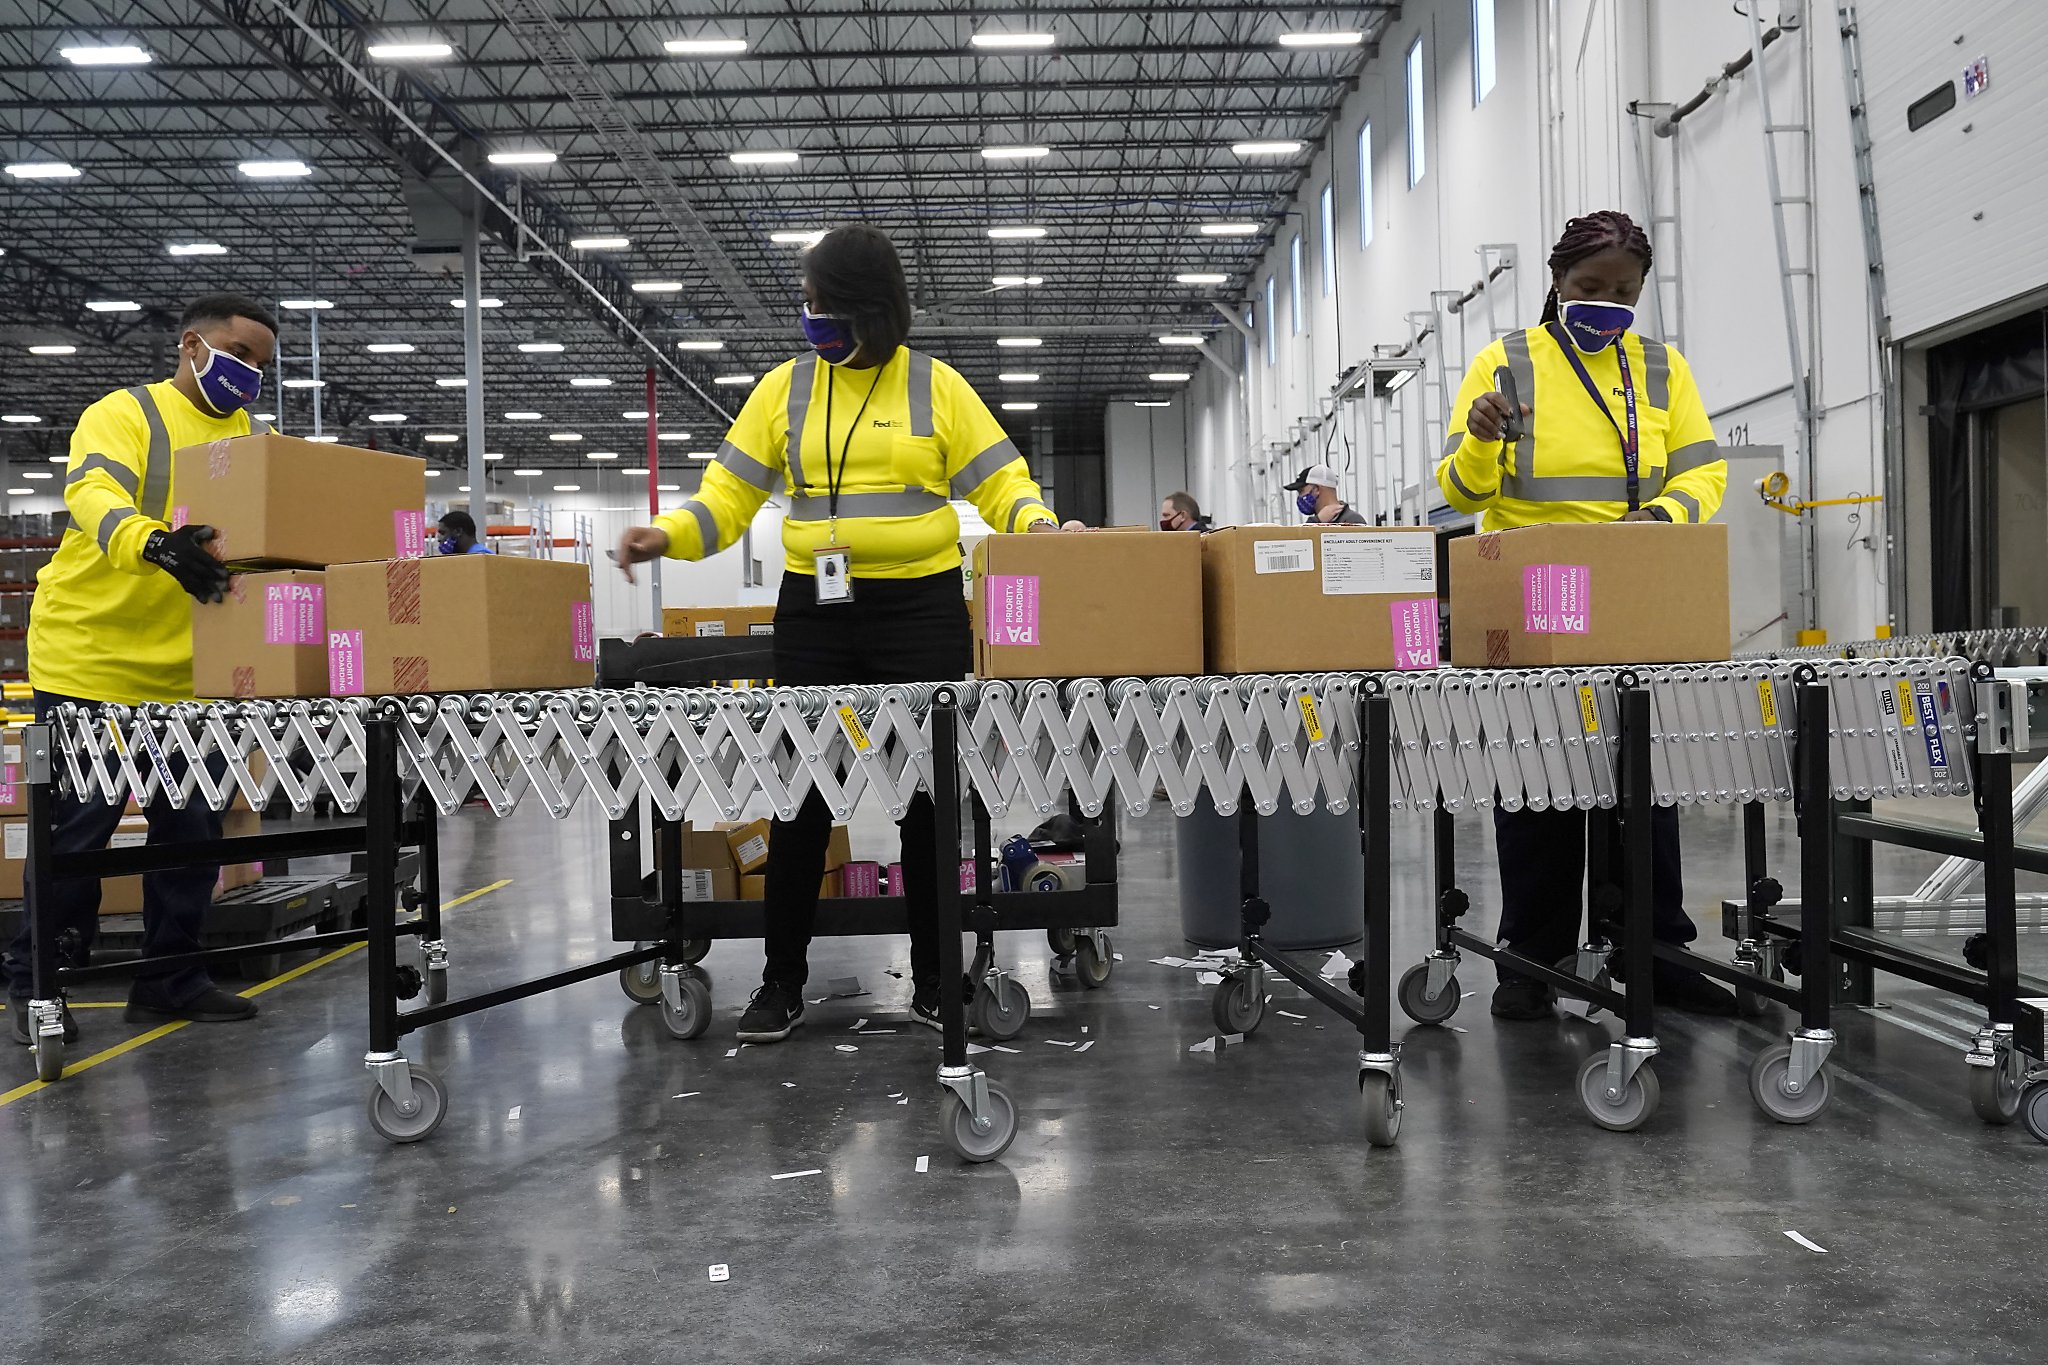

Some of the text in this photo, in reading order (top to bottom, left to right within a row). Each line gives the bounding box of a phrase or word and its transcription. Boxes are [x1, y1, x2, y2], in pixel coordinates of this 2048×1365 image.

[1728, 422, 1748, 446] 121
[268, 587, 282, 600] PA
[292, 586, 313, 601] PA
[1403, 609, 1412, 647] PRIORITY
[1412, 602, 1421, 646] BOARDING
[1533, 614, 1548, 630] PA
[1562, 615, 1584, 631] PA
[330, 633, 352, 648] PA
[1006, 626, 1032, 642] PA
[580, 645, 592, 659] PA
[1407, 649, 1432, 666] PA
[1883, 691, 1894, 714] ULINE
[1310, 708, 1319, 730] WARNING
[1922, 696, 1942, 763] BEST FLEX
[146, 734, 171, 784] BEST FLEX
[960, 864, 975, 875] PA
